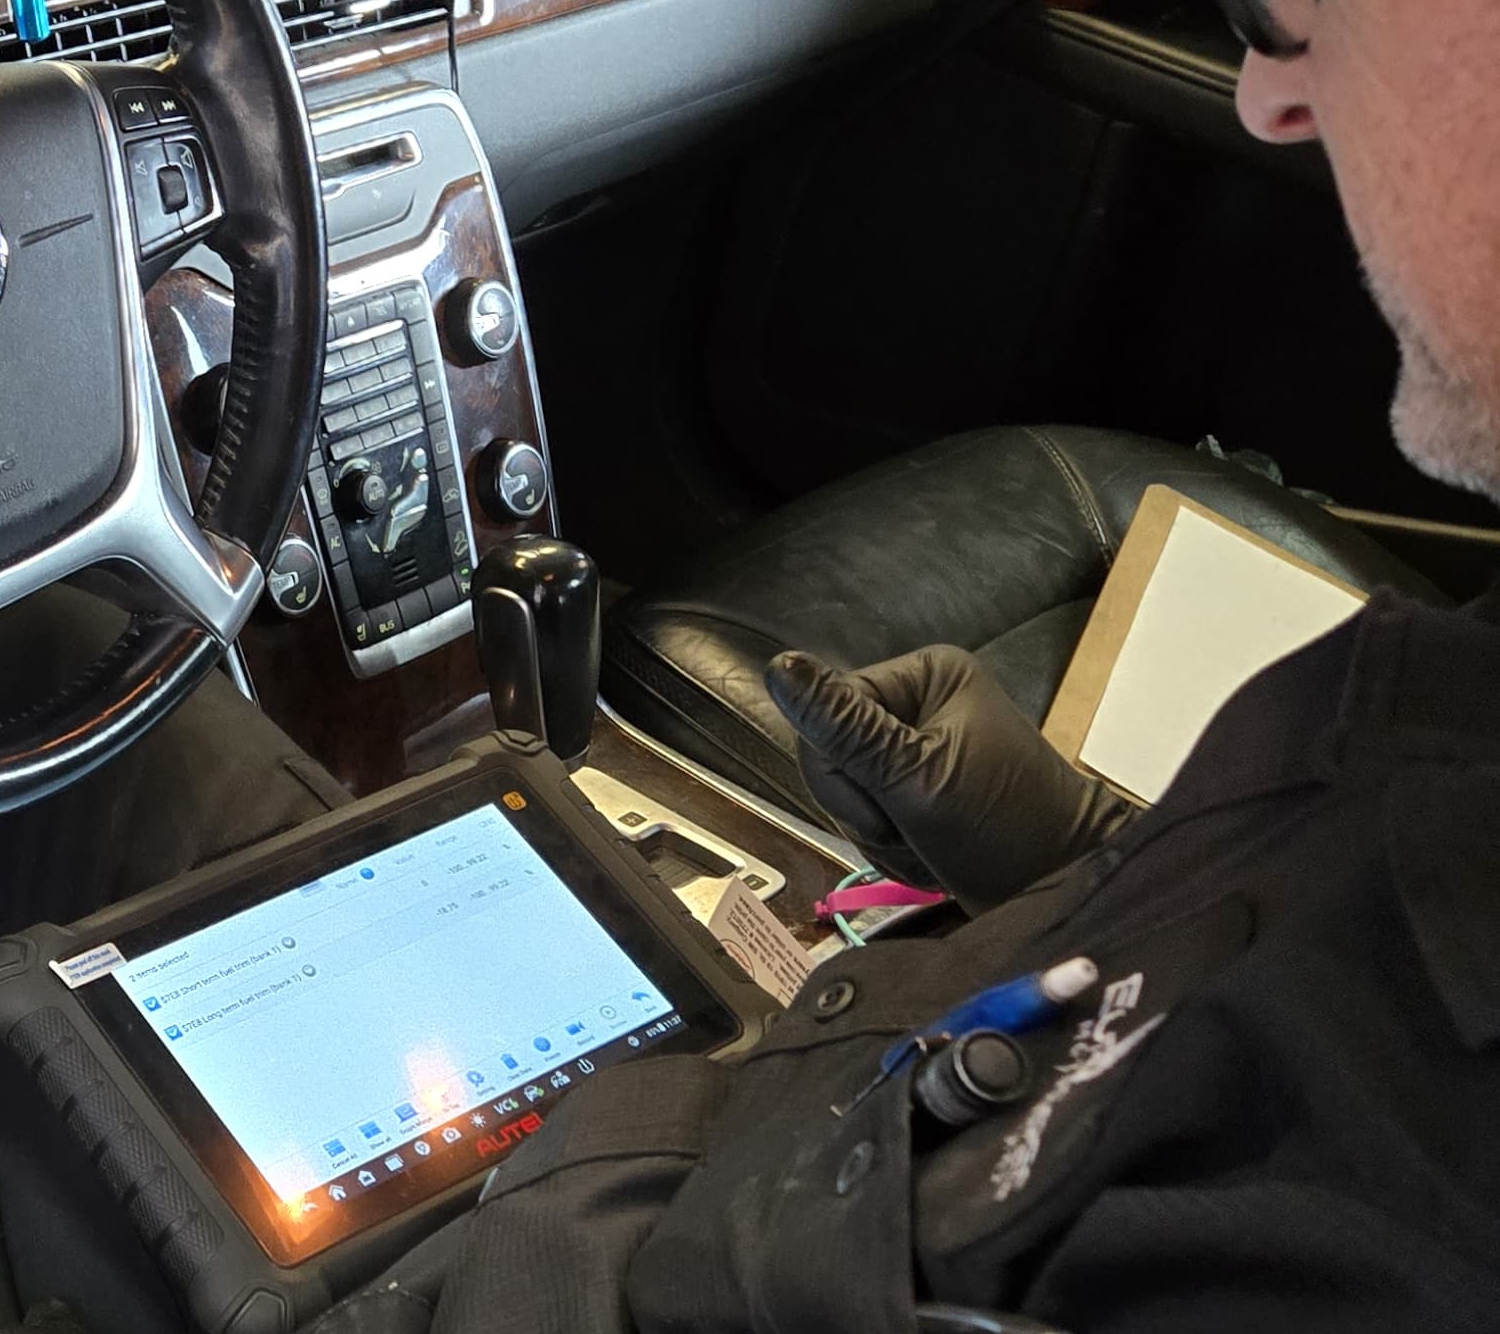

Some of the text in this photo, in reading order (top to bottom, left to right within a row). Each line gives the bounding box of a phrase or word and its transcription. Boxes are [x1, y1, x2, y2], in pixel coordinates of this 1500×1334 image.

[368, 488, 385, 502] AUTO
[379, 619, 395, 634] BUS
[158, 950, 190, 973] selected
[180, 981, 202, 996] Short
[202, 971, 222, 987] term
[220, 964, 236, 980] fuel
[250, 949, 273, 967] (bank
[202, 1009, 224, 1026] Long
[222, 1000, 242, 1015] term
[239, 993, 255, 1009] fuel
[254, 987, 271, 1002] trim
[270, 977, 293, 995] (bank
